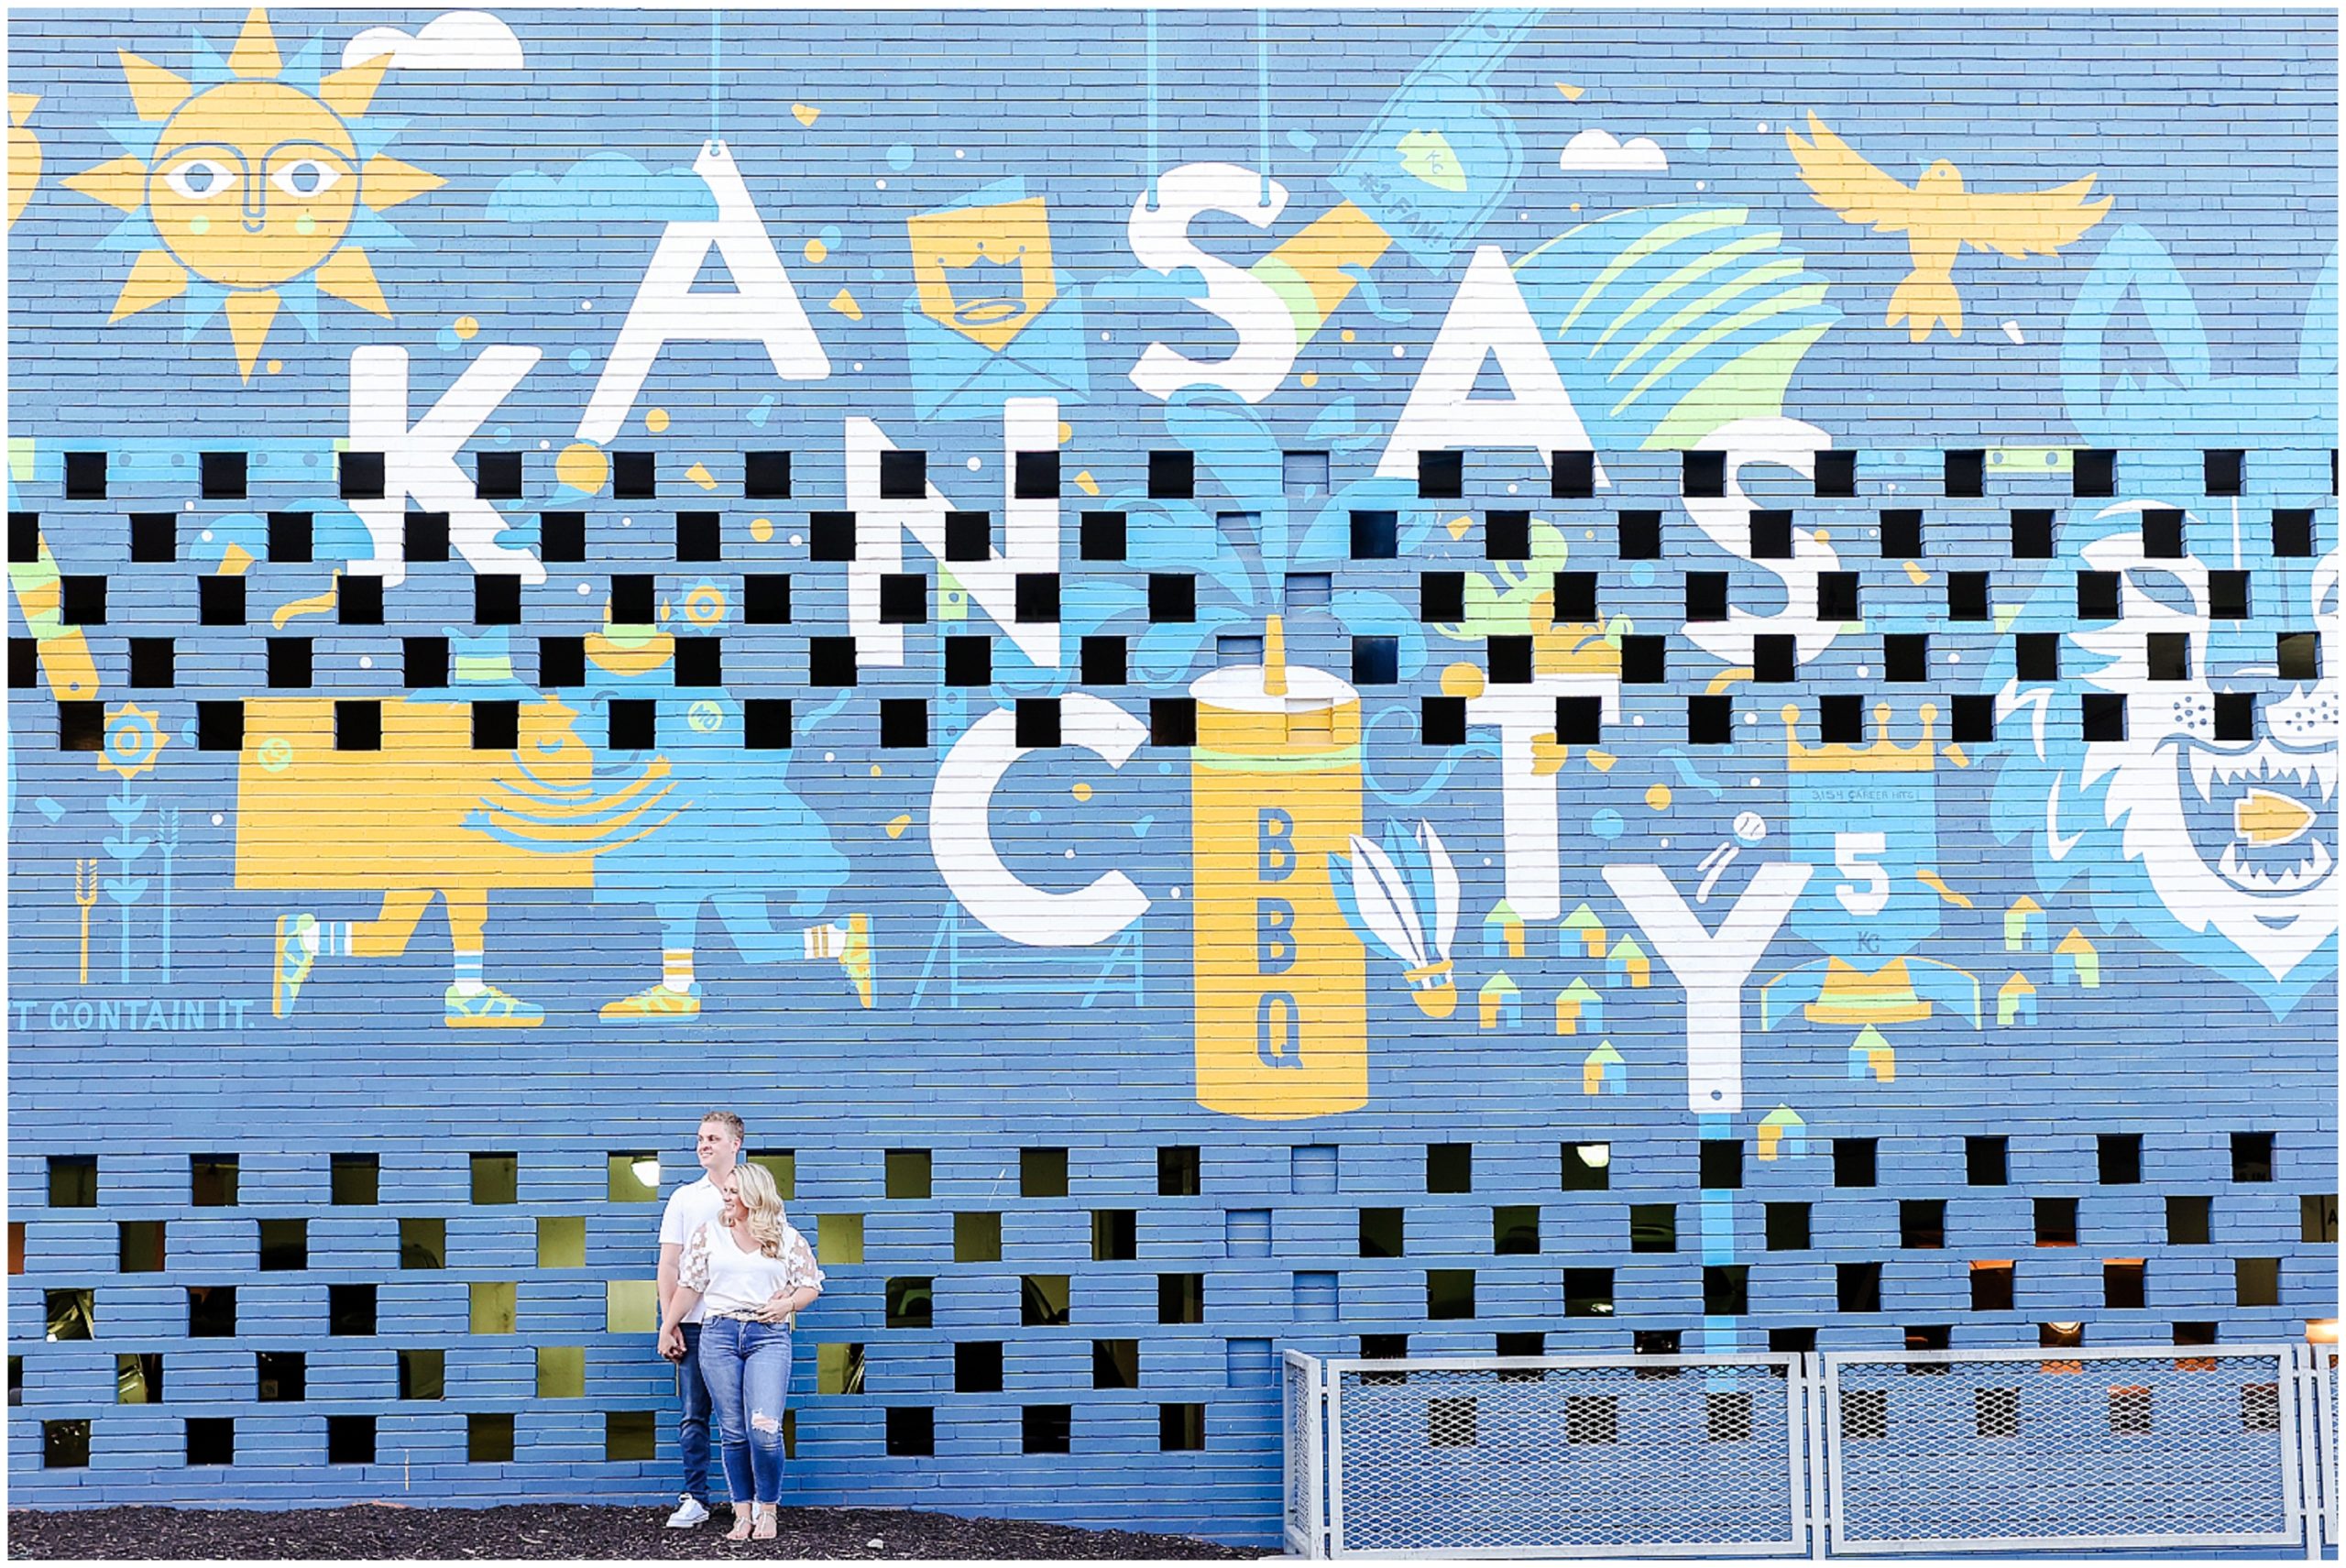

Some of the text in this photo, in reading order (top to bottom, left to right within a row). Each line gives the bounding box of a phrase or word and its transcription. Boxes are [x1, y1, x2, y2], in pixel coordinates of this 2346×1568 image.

[1359, 172, 1390, 203] #1
[349, 139, 1841, 667] KANSAS
[1848, 789, 1889, 800] CAREER
[1835, 832, 1890, 916] 5
[1258, 807, 1303, 1069] BBQ
[49, 1000, 204, 1032] CONTAIN
[218, 1000, 256, 1031] IT.
